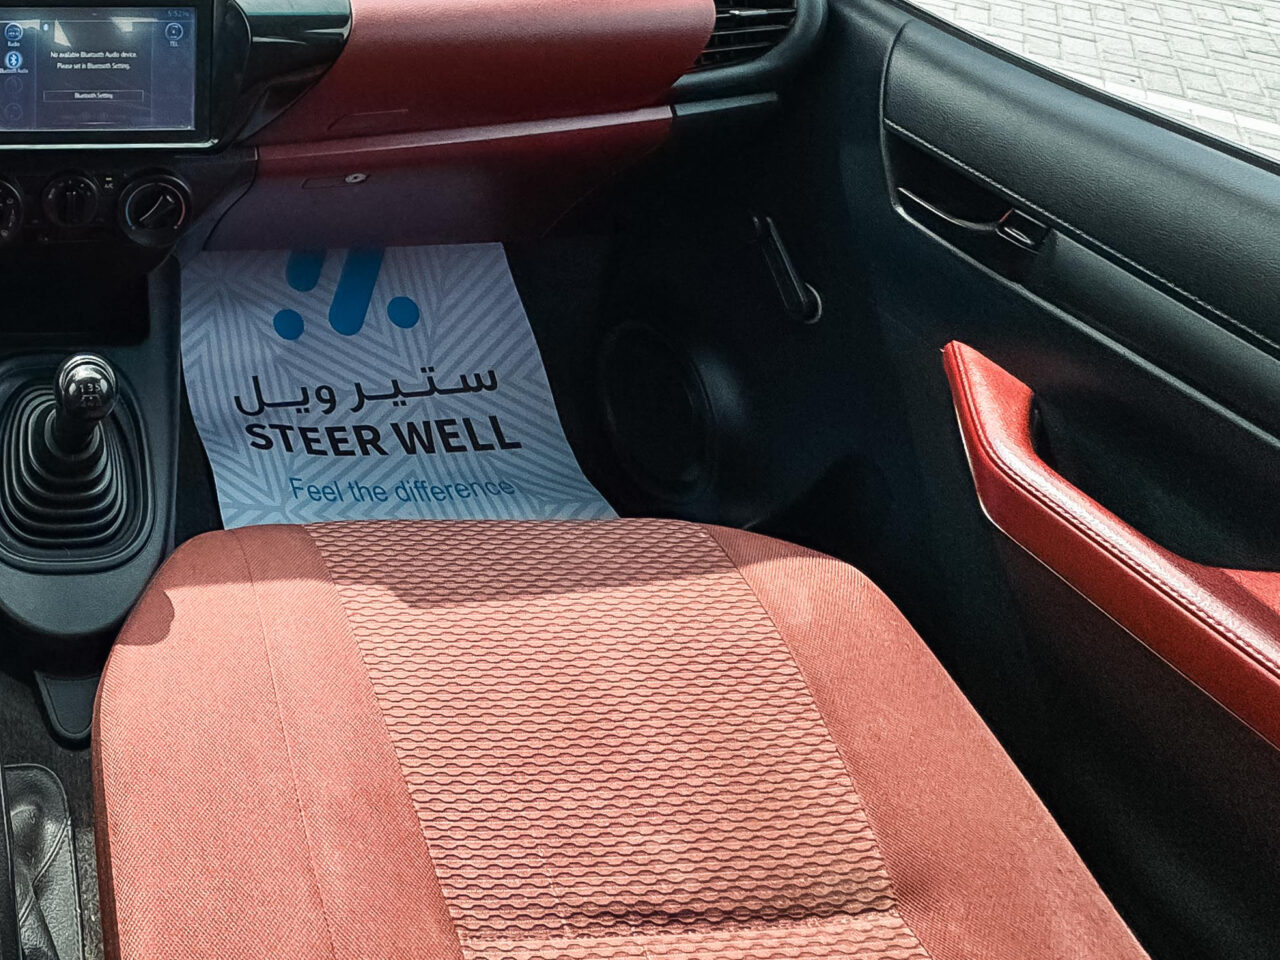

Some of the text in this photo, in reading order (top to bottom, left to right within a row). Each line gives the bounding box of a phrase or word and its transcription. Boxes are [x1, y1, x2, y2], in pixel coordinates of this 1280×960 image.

[87, 383, 93, 392] 3
[233, 375, 336, 416] ويل
[245, 415, 523, 457] STEER WELL
[288, 477, 516, 504] Feel the difference
